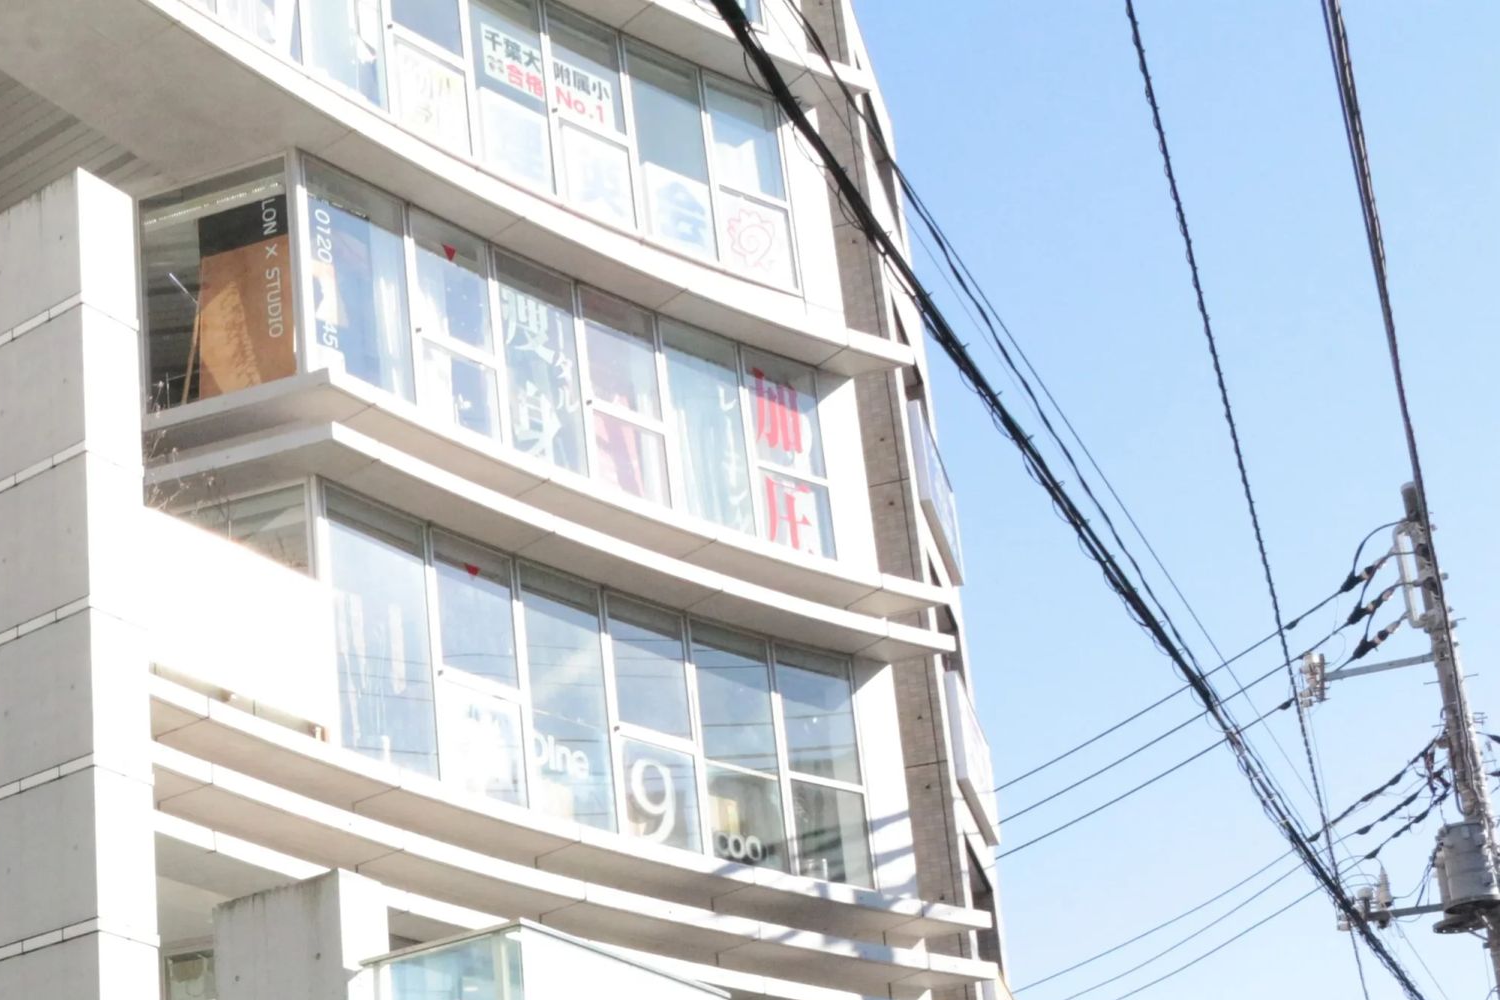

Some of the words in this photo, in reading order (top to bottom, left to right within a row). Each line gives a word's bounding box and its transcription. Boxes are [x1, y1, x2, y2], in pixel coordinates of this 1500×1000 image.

[505, 63, 544, 97] 合格
[556, 86, 605, 123] No.1
[315, 209, 332, 264] 0120
[265, 267, 283, 338] STUDIO
